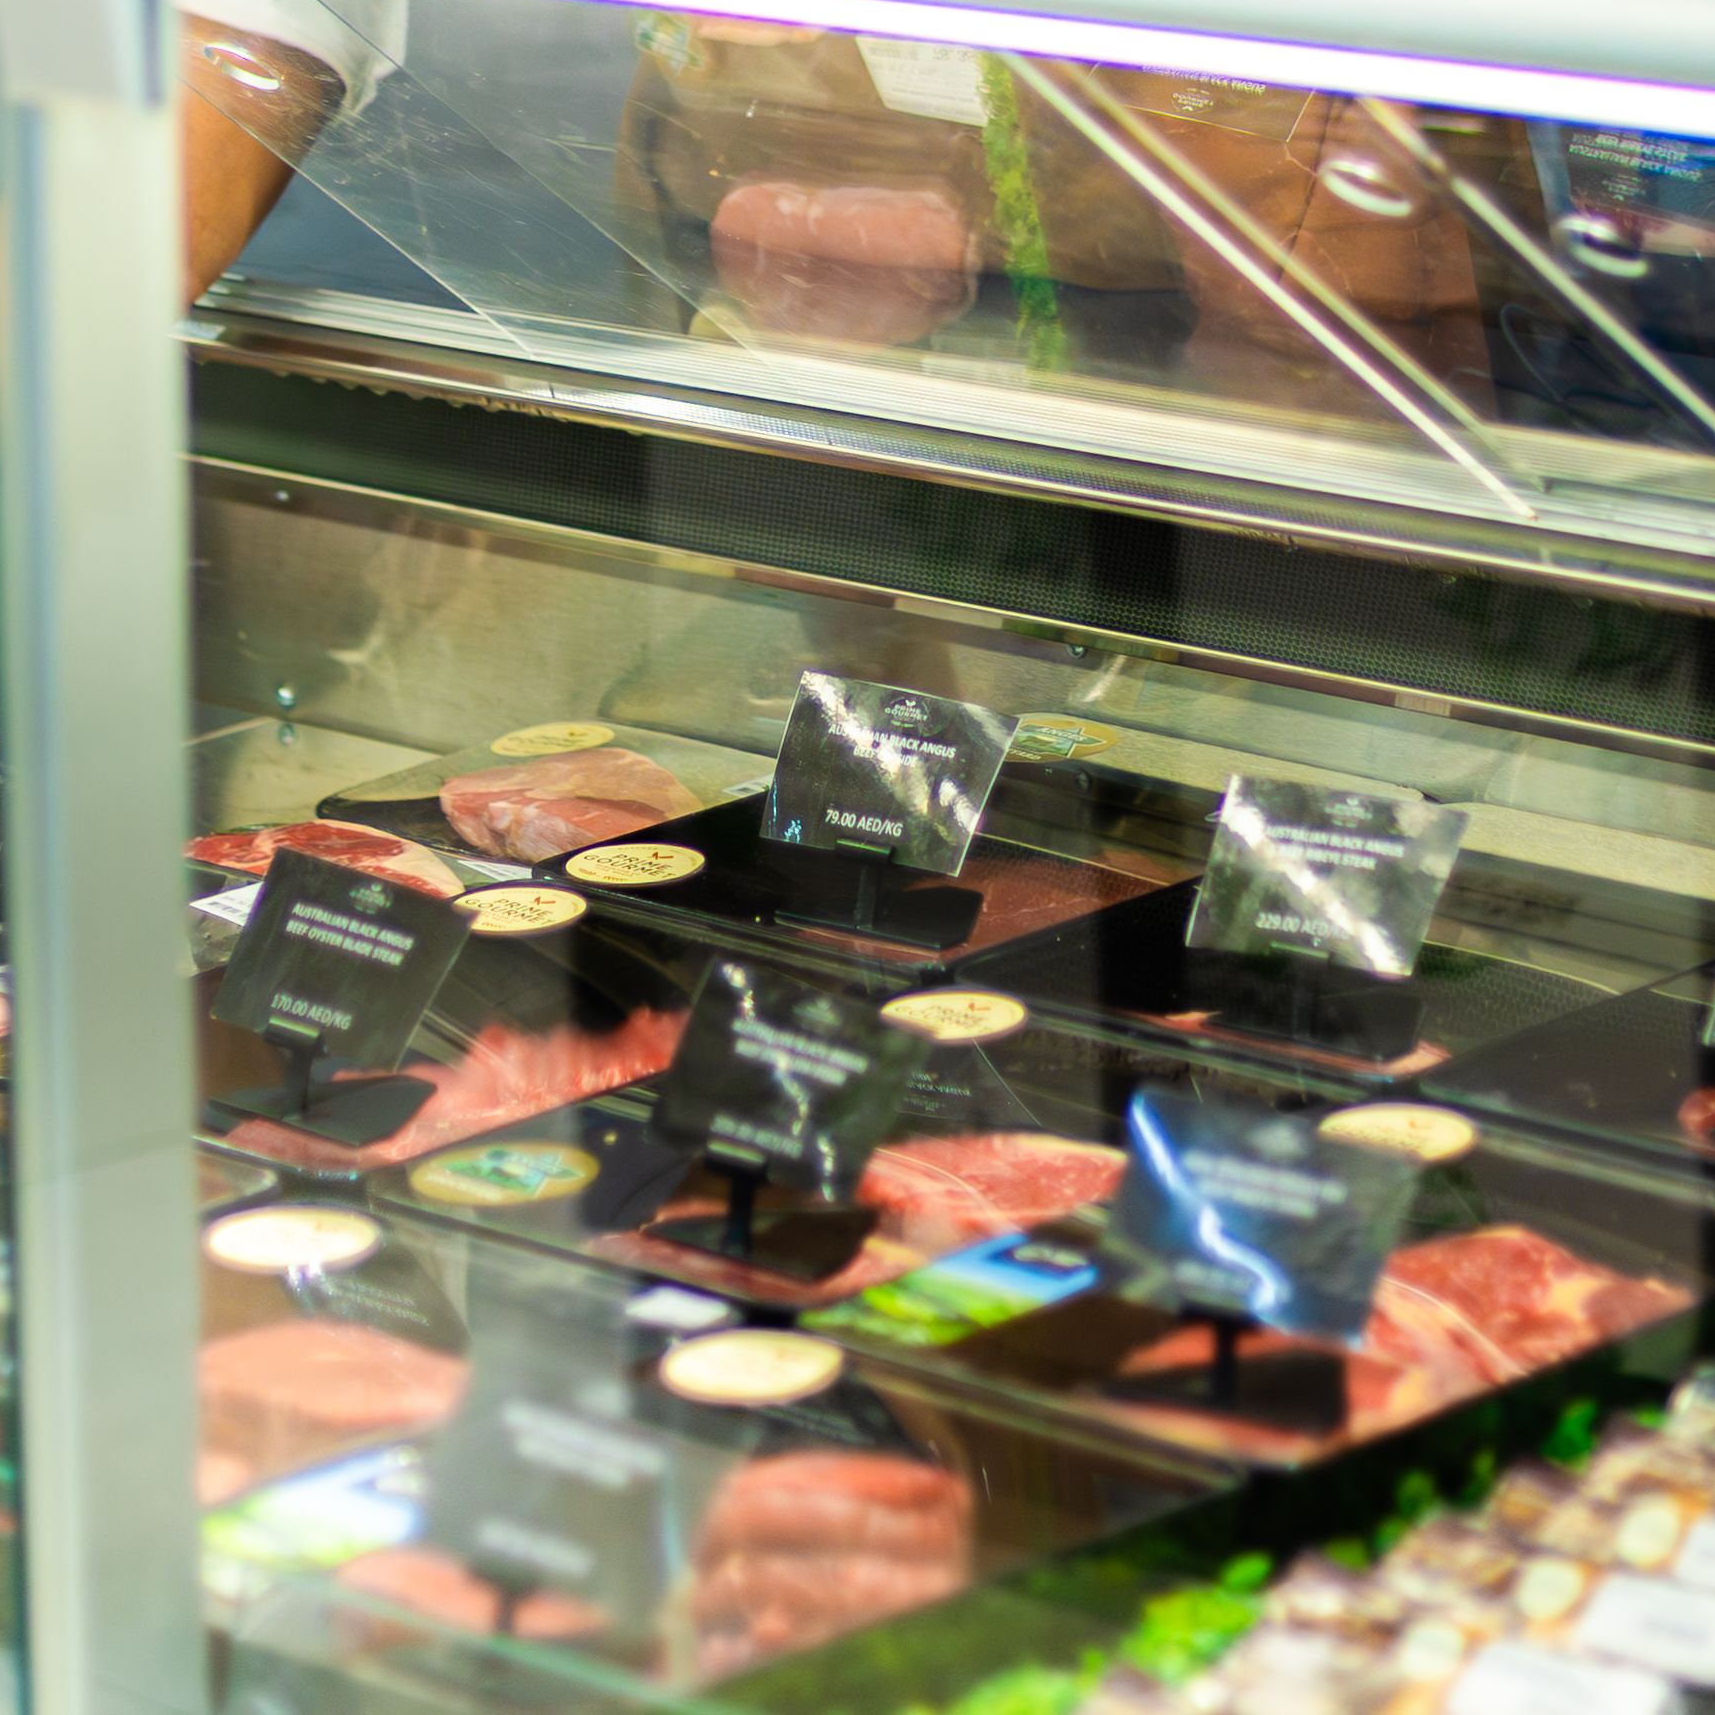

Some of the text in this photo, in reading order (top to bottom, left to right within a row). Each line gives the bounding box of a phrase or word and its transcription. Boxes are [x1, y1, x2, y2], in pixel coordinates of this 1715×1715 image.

[887, 732, 921, 751] BLACK
[919, 741, 957, 759] ANGUS
[825, 809, 904, 837] 79.00 AED/KG
[583, 853, 677, 880] GOURMET
[613, 853, 675, 873] PRIME
[464, 897, 556, 927] GOURMET
[495, 897, 556, 917] PRIME
[292, 902, 415, 951] AUSTRALIAN BLACK ANGUS
[286, 919, 406, 966] BEEF OYSTER BLADE STEAK
[270, 993, 353, 1030] 170.00 AED/KG
